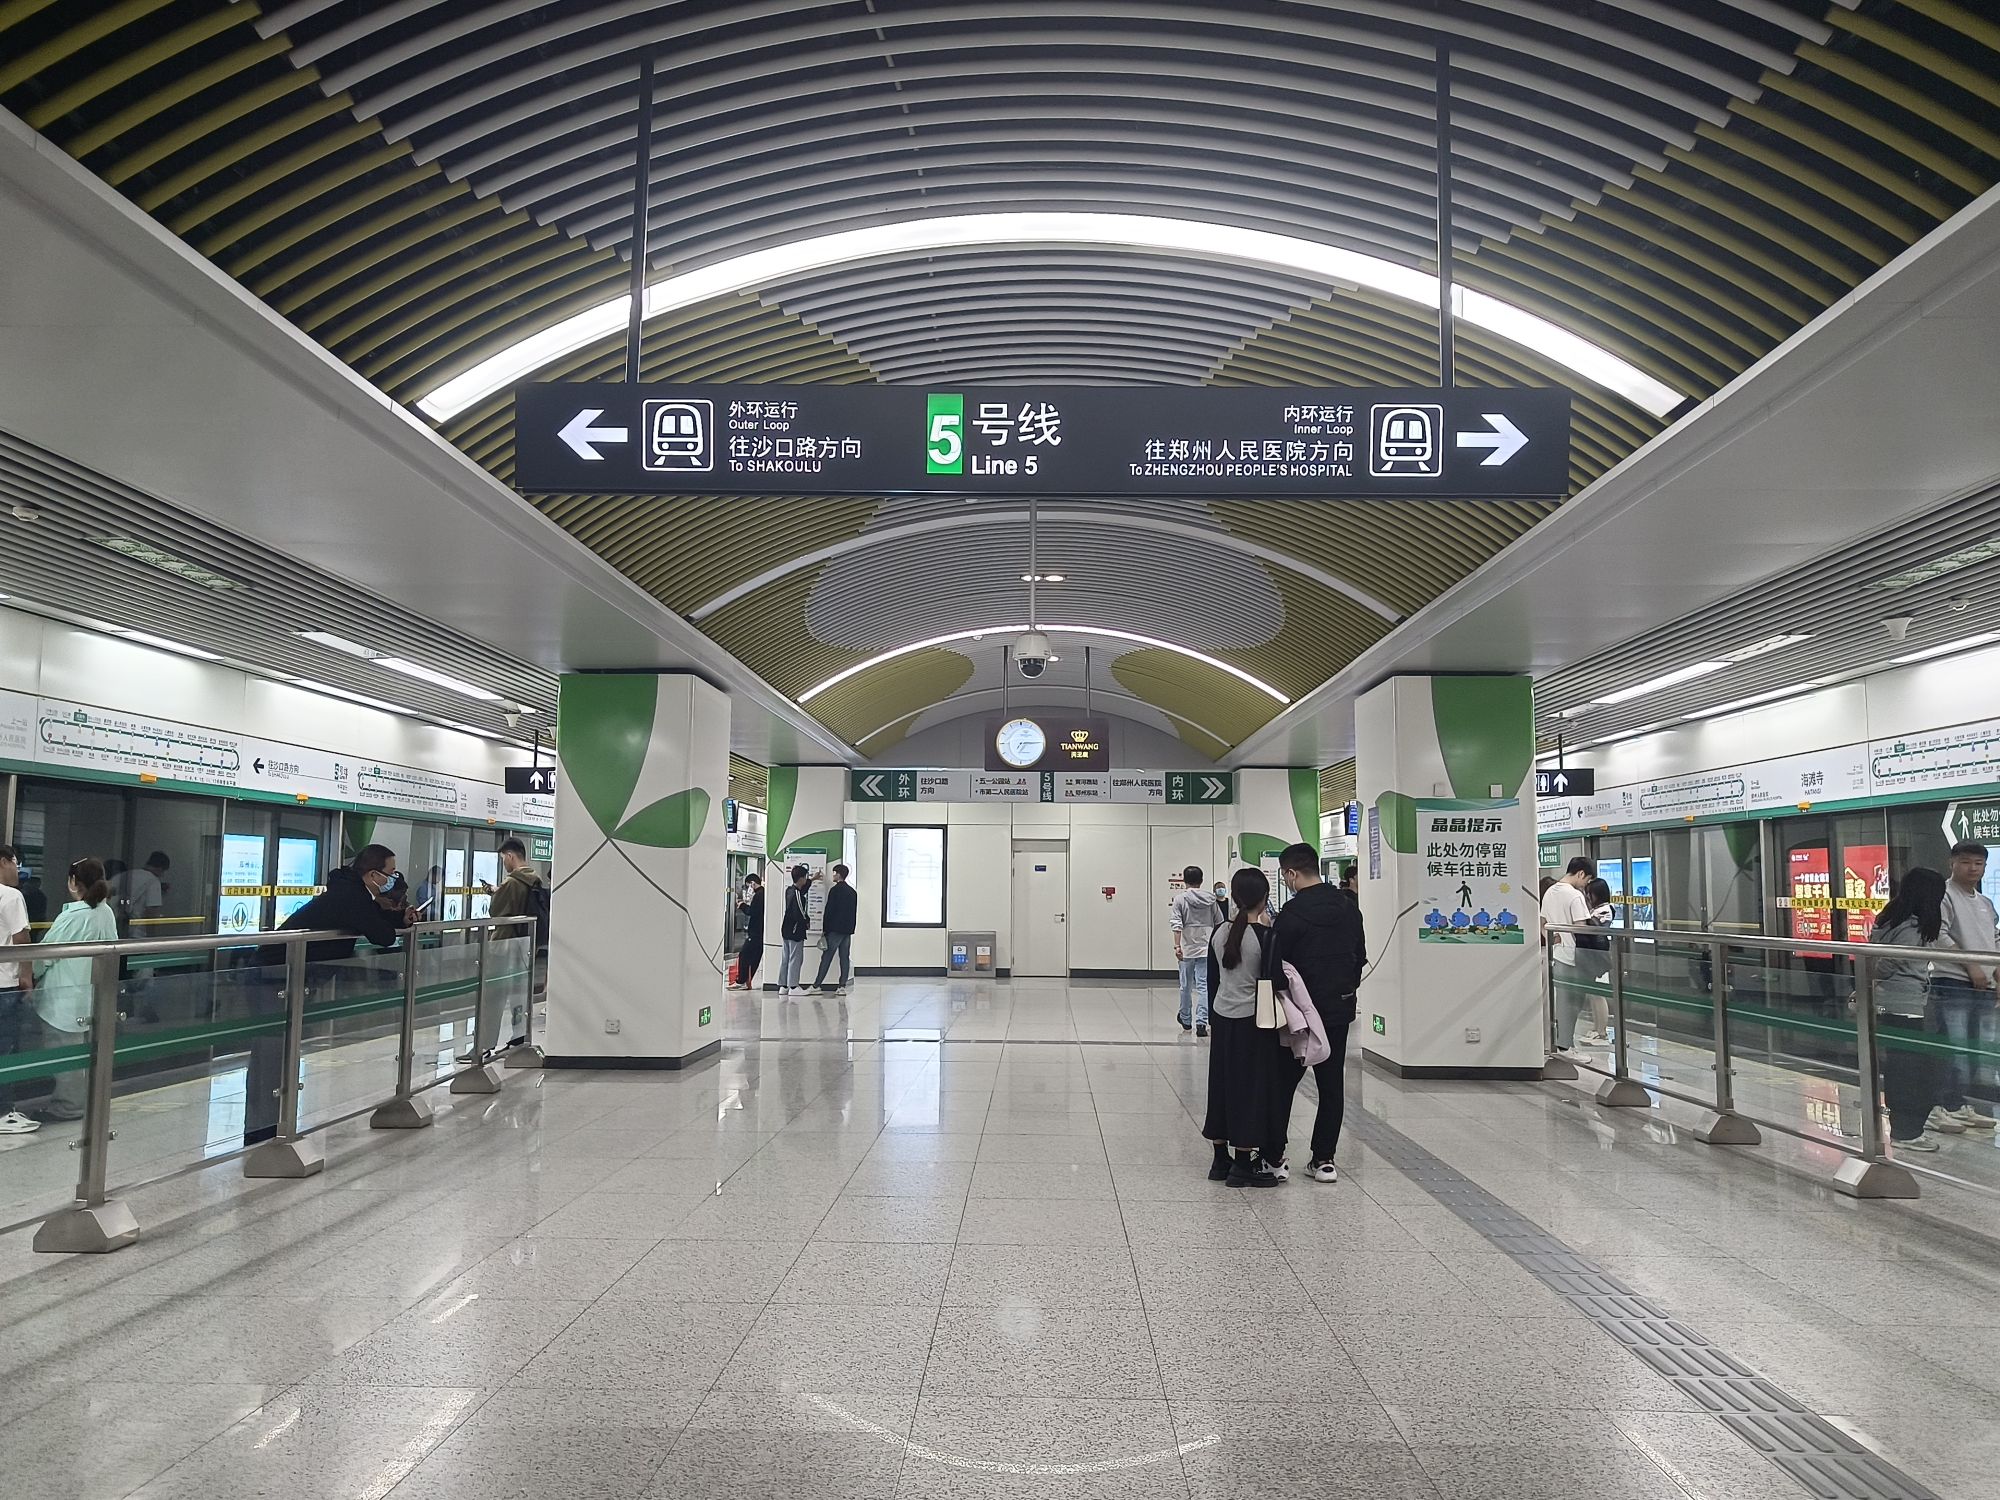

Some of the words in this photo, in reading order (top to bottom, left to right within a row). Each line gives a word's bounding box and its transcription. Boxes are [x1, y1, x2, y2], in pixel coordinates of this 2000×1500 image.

[728, 401, 798, 419] 外环运行
[1284, 405, 1353, 422] 内环运行
[729, 419, 758, 430] Outer
[764, 419, 790, 432] Loop
[1294, 424, 1322, 434] Inner
[1327, 424, 1353, 436] Loop
[928, 413, 962, 465] 5
[973, 403, 1061, 445] 号线
[729, 436, 861, 459] 往沙口路方向
[1145, 439, 1353, 461] 往郑州人民医院方向
[729, 460, 743, 472] To
[748, 460, 822, 473] SHAKOULU
[972, 456, 1017, 474] Line
[1025, 456, 1037, 474] 5
[1130, 464, 1143, 476] To
[1144, 464, 1224, 477] ZHENGZHOU
[1226, 464, 1288, 477] PEOPLE'S
[1290, 464, 1353, 477] HOSPITAL
[1060, 743, 1099, 751] TIANWANG
[898, 774, 910, 799] 外环
[920, 778, 949, 786] 往沙口路
[1112, 778, 1163, 787] 往郑州人民医院
[1801, 771, 1824, 787] 海滩寺
[920, 787, 935, 795] 方向
[1148, 789, 1163, 797] 方向
[1172, 775, 1184, 801] 内环
[1973, 808, 2000, 823] 此处勿
[1431, 817, 1503, 833] 晶晶提示
[1427, 843, 1507, 859] 此处勿停留
[1427, 861, 1508, 877] 候车往前走
